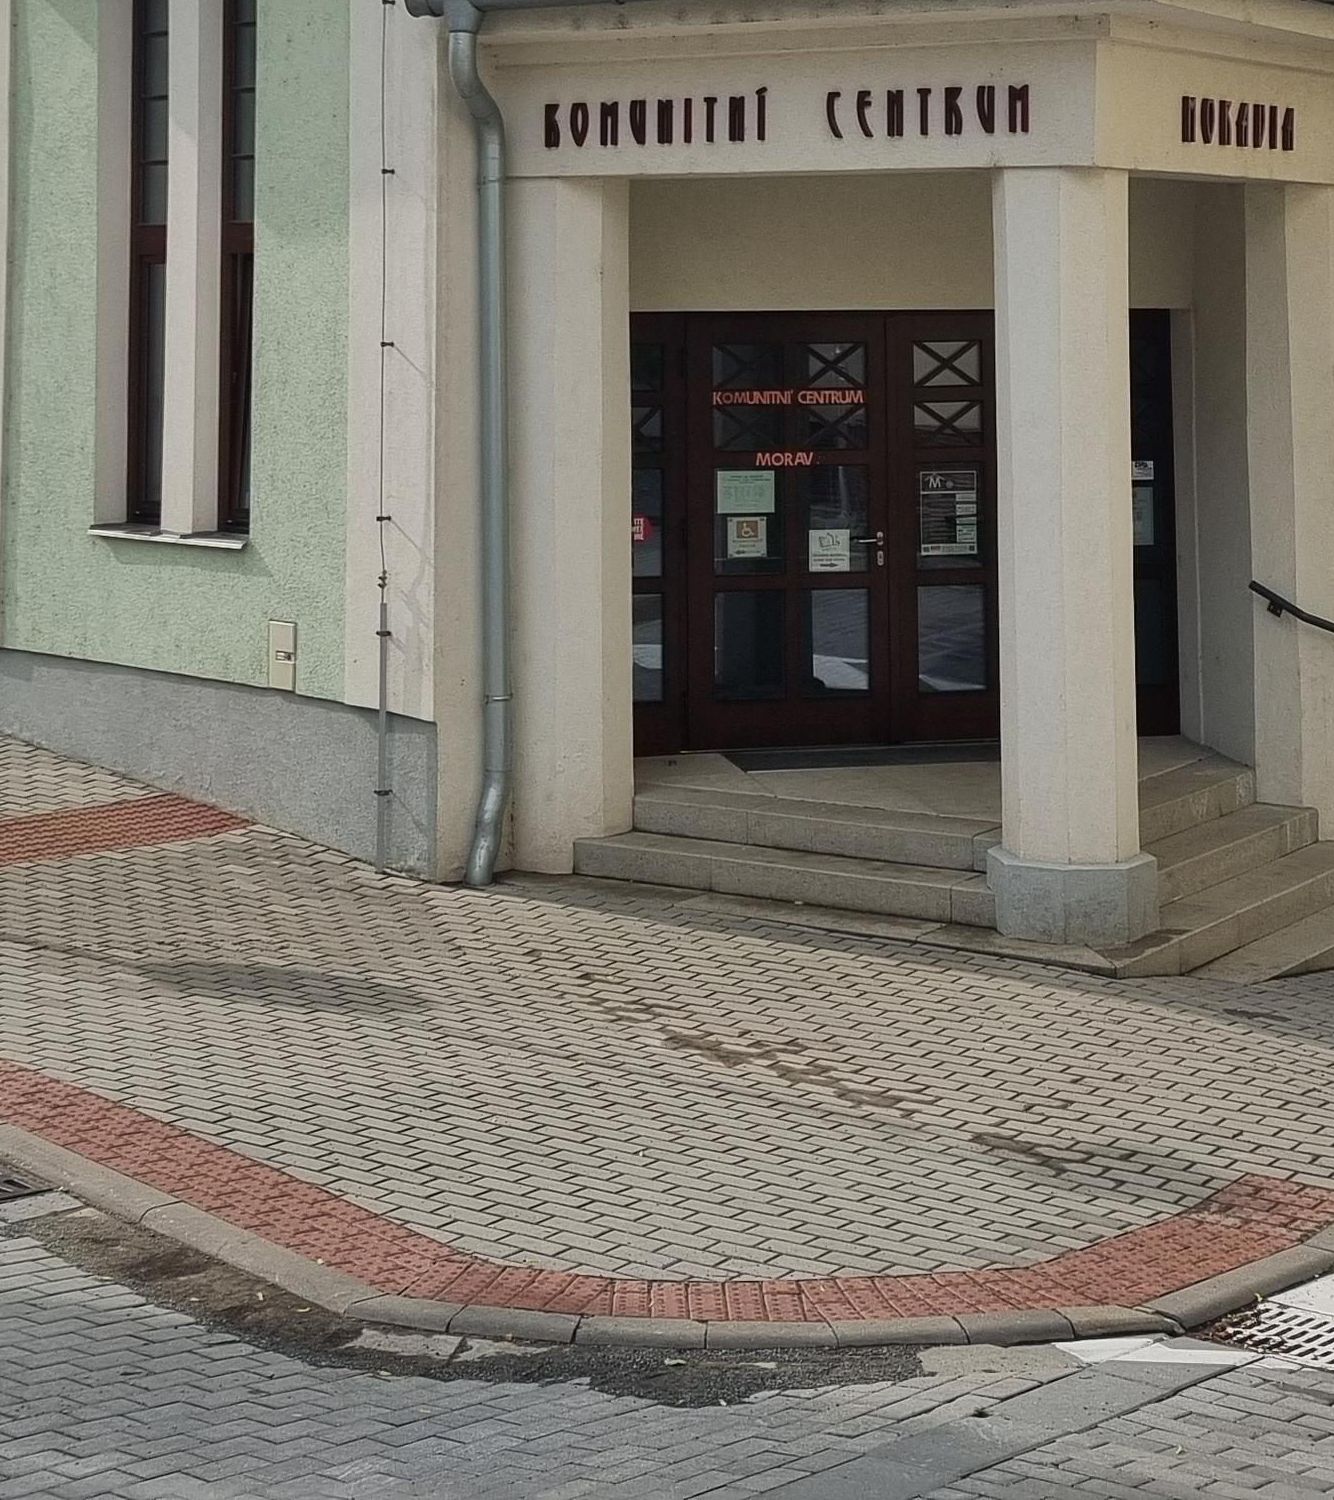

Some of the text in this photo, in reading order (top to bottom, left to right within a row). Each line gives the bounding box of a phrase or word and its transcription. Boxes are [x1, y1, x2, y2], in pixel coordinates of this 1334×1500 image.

[544, 84, 1029, 148] KOMUNITNÍ CENTRUM
[1180, 95, 1295, 151] MORAVIA
[713, 389, 864, 405] KOMUNITNÍ CENTRUM
